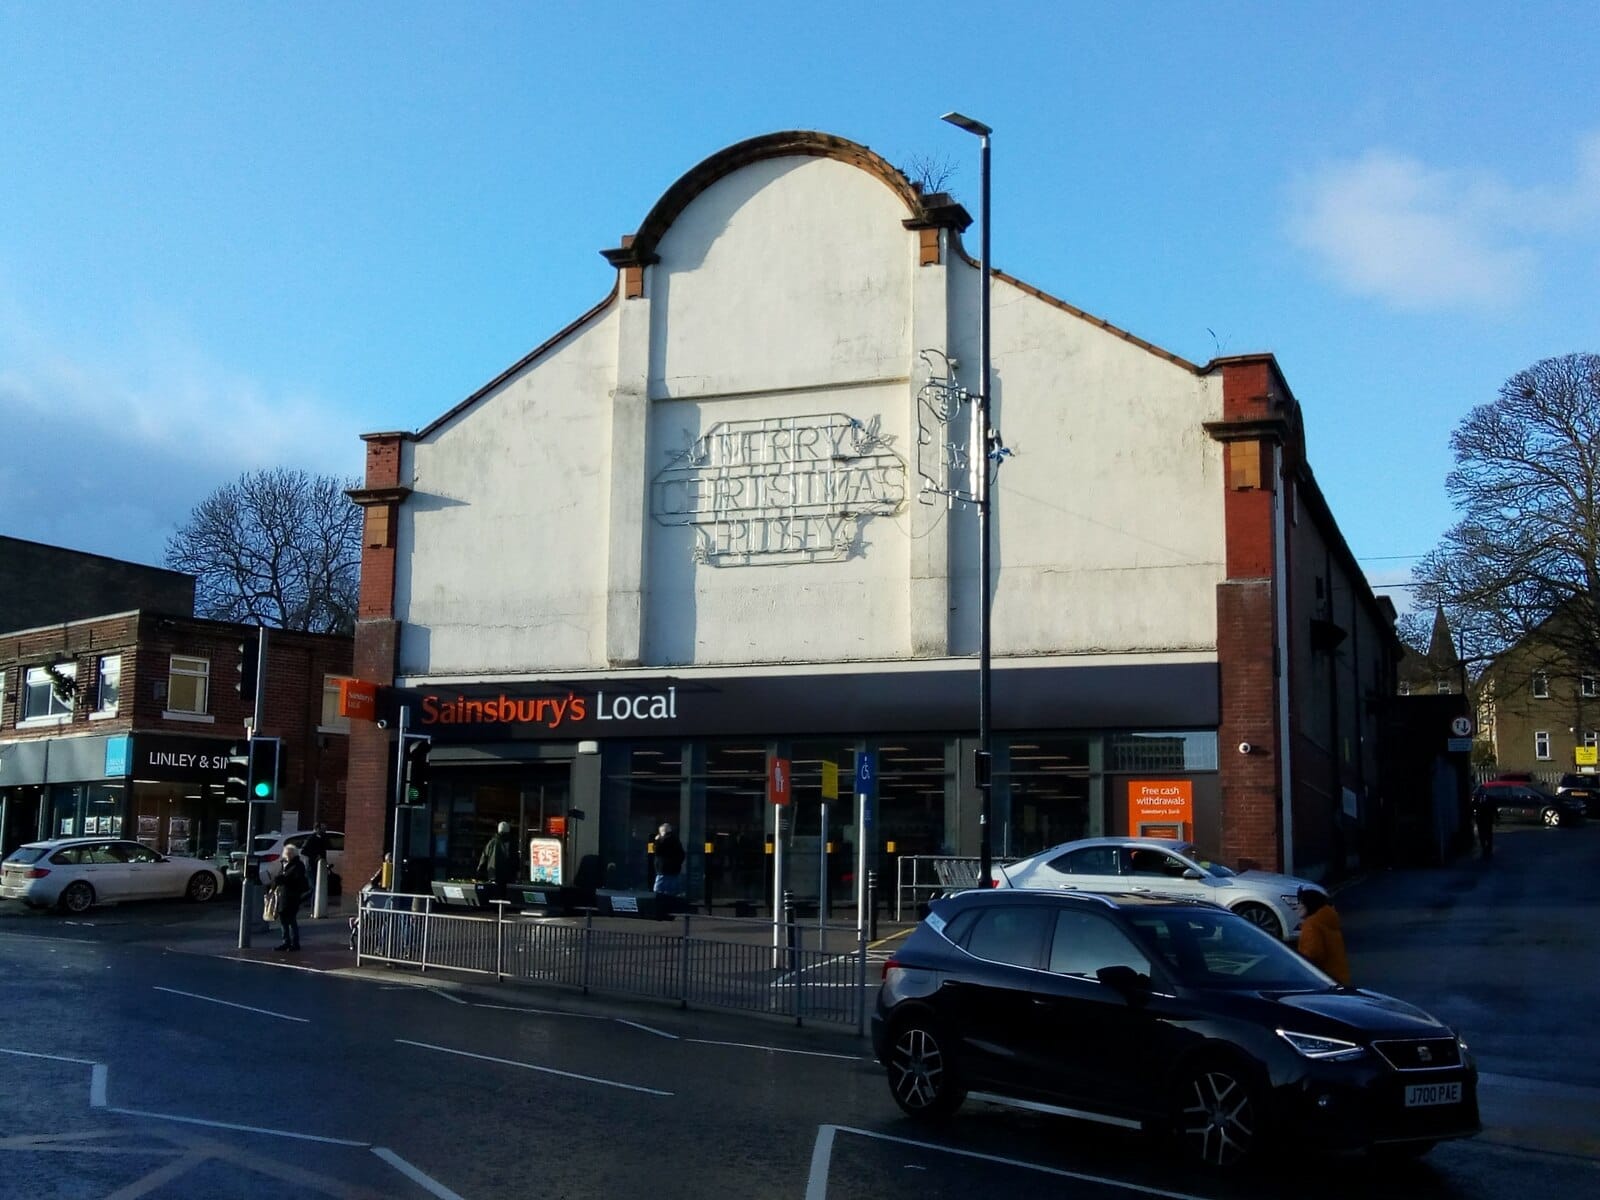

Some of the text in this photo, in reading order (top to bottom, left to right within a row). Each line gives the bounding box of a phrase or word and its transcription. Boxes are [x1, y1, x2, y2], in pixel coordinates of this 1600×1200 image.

[712, 426, 846, 466] MERRY
[661, 469, 905, 516] CHRISTMAS
[420, 686, 677, 728] Sainsbury's Local
[149, 751, 197, 768] LINLEY
[199, 756, 209, 769] &
[1136, 796, 1185, 805] withdrawals
[1141, 786, 1180, 795] Free cash
[1409, 1084, 1458, 1105] J700 PAE
